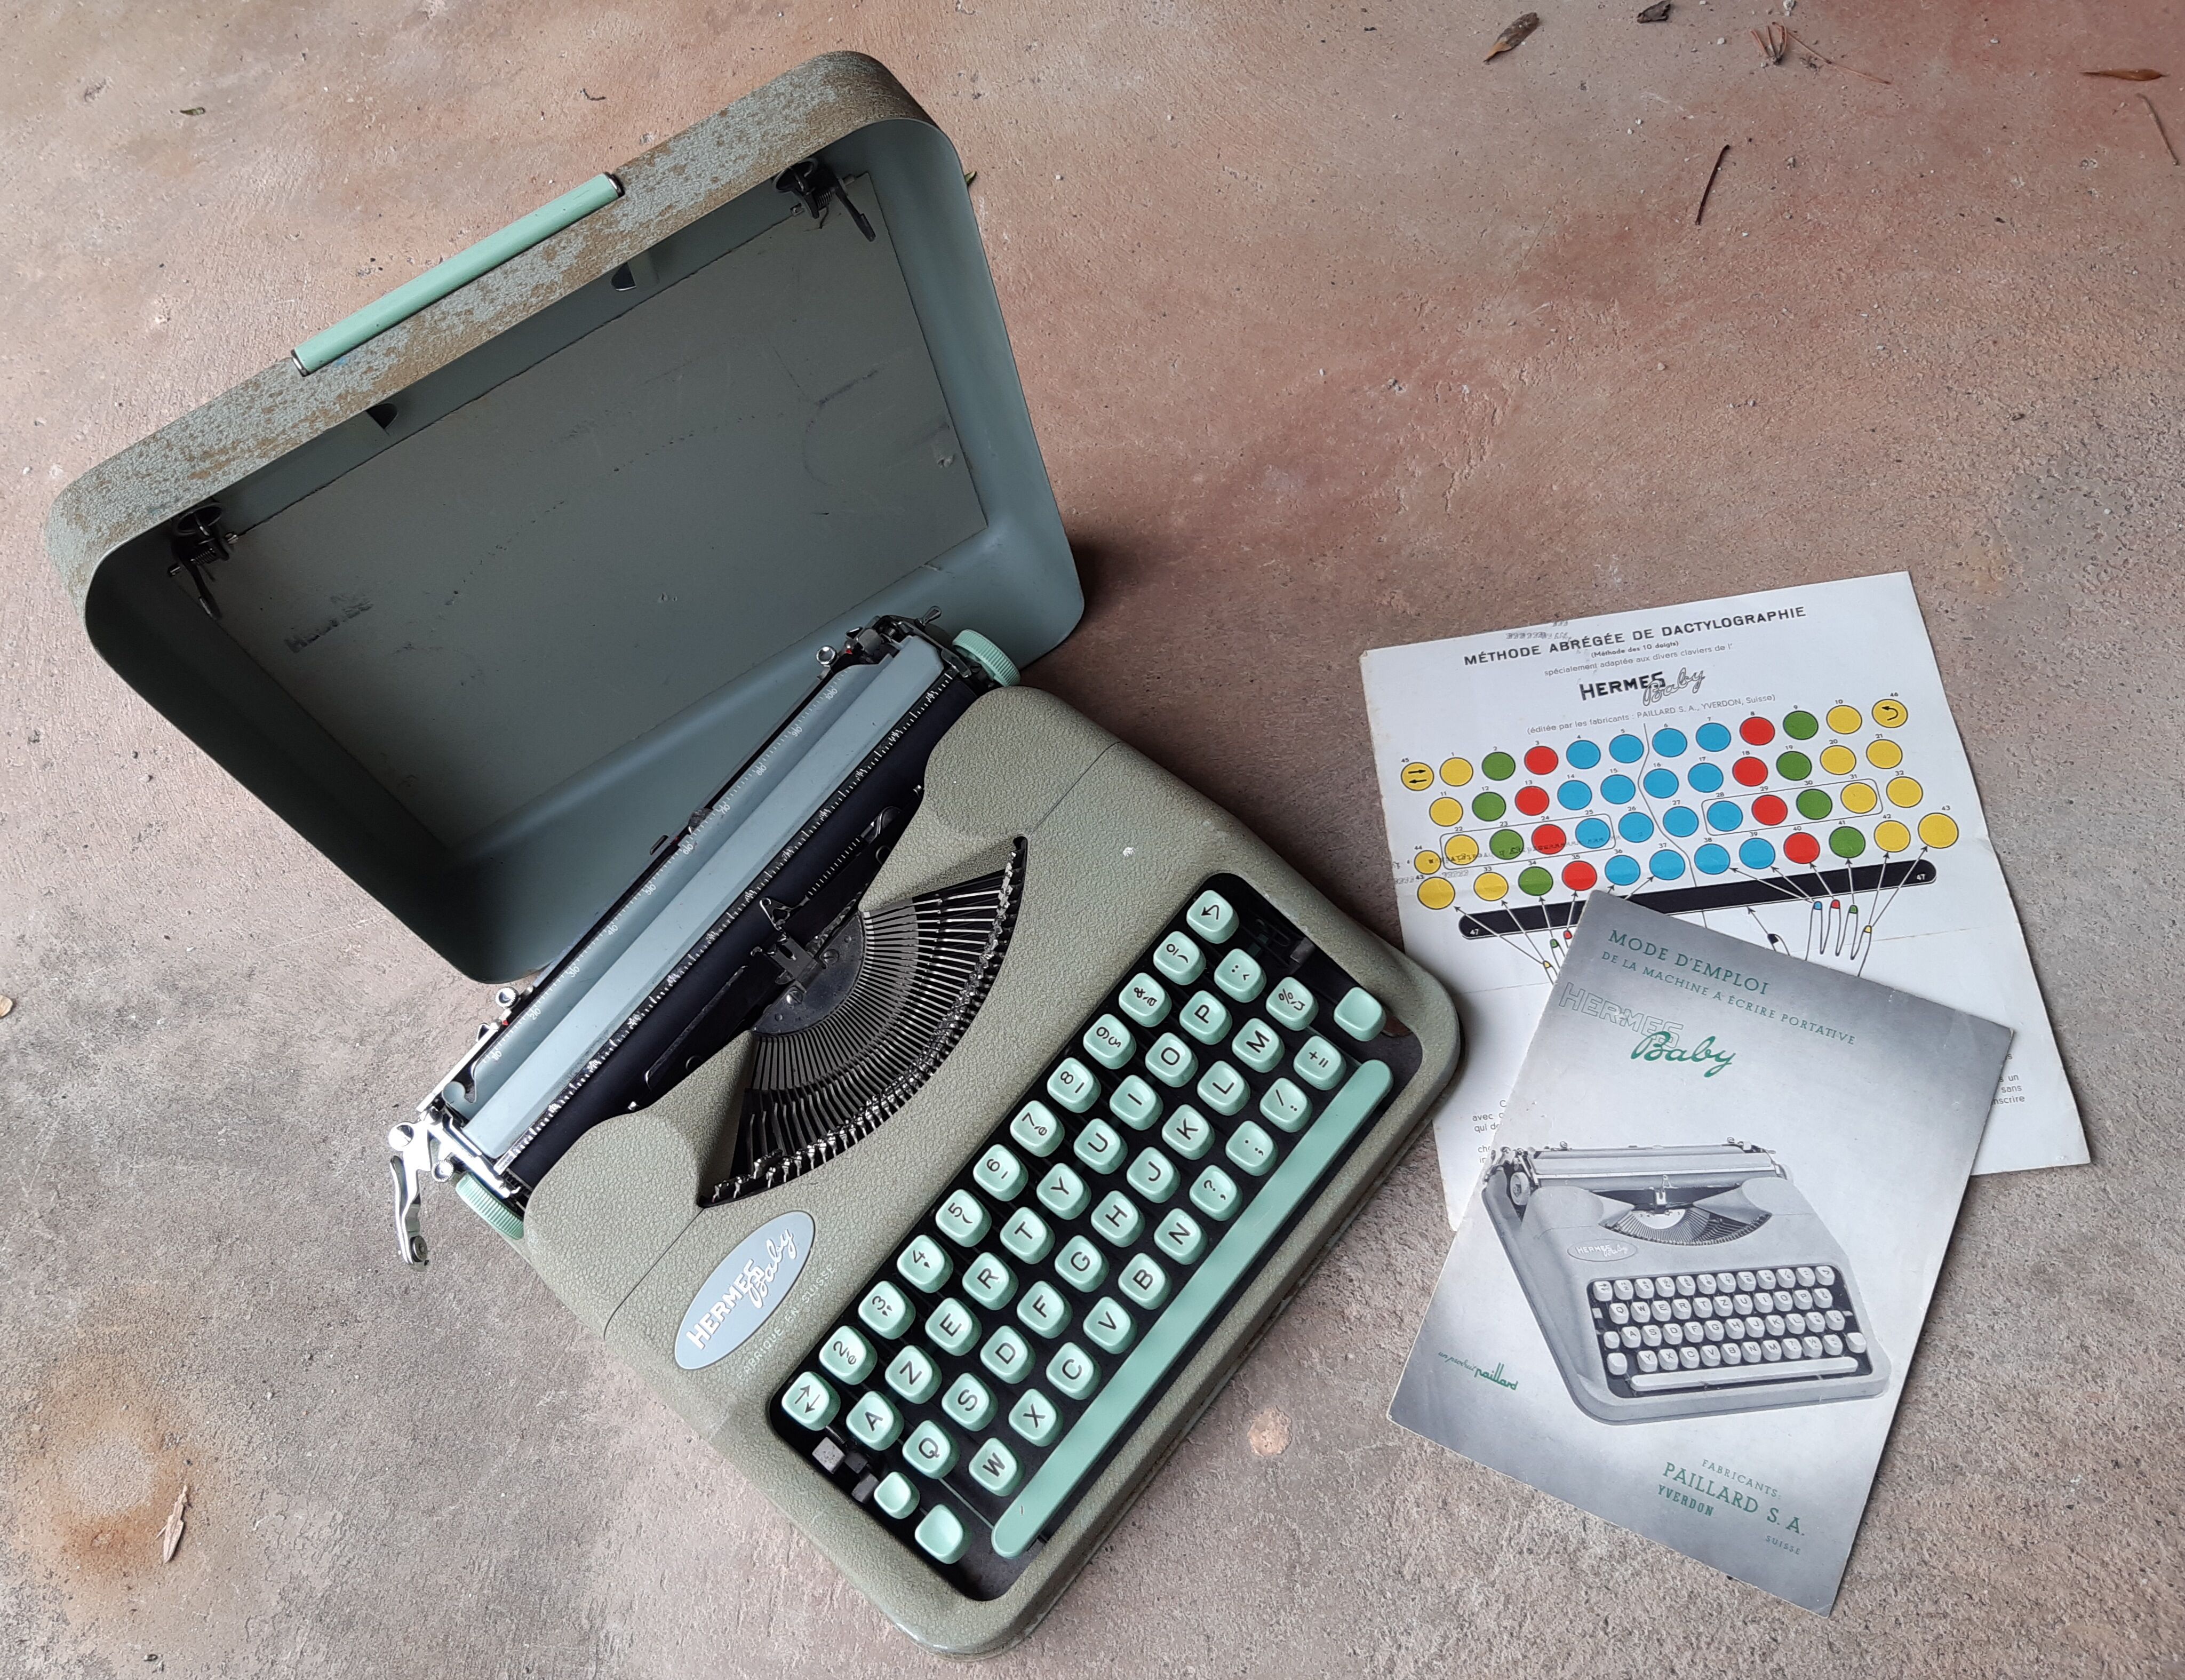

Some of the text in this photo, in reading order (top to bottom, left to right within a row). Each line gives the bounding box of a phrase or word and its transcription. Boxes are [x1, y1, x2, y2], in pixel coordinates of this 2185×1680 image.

[1464, 646, 1541, 665] MÉTHODE
[1550, 633, 1624, 652] ABRÉGÉE
[1633, 629, 1654, 640] DE
[1662, 607, 1806, 636] DACTYLOGRAPHIE
[1545, 663, 1597, 676] spécialement
[1600, 658, 1633, 667] adaptée
[1681, 647, 1713, 656] claviers
[1591, 649, 1625, 658] (Méthode
[1527, 725, 1556, 735] (éditée
[1590, 715, 1629, 724] fabricants
[1637, 707, 1676, 718] PAILLARD
[1701, 699, 1743, 709] YVERDON,
[1746, 694, 1775, 703] Suisse)
[1579, 667, 1705, 706] HERMES Baby
[1608, 930, 1768, 994] MODE D'EMPLOI
[1601, 952, 1618, 964] DE
[1622, 959, 1636, 971] LA
[1642, 967, 1708, 996] MACHINE
[1728, 995, 1775, 1018] ÉCRIRE
[1781, 1014, 1855, 1045] PORTATIVE
[1559, 982, 1736, 1077] HERMES Baby
[1474, 1124, 1487, 1133] qui
[864, 1004, 1209, 1431] A Z E R T Y U I O P
[919, 1031, 1269, 1459] Q S D F G H J K L M
[686, 1229, 797, 1349] HERMES Baby
[983, 1223, 1189, 1477] W X C V B N
[1446, 1358, 1477, 1371] produit
[1474, 1362, 1518, 1391] paillard
[1657, 1485, 1714, 1516] YVERDON
[1662, 1462, 1805, 1536] PAILLARD S. A.
[1766, 1535, 1801, 1555] SUISSE
